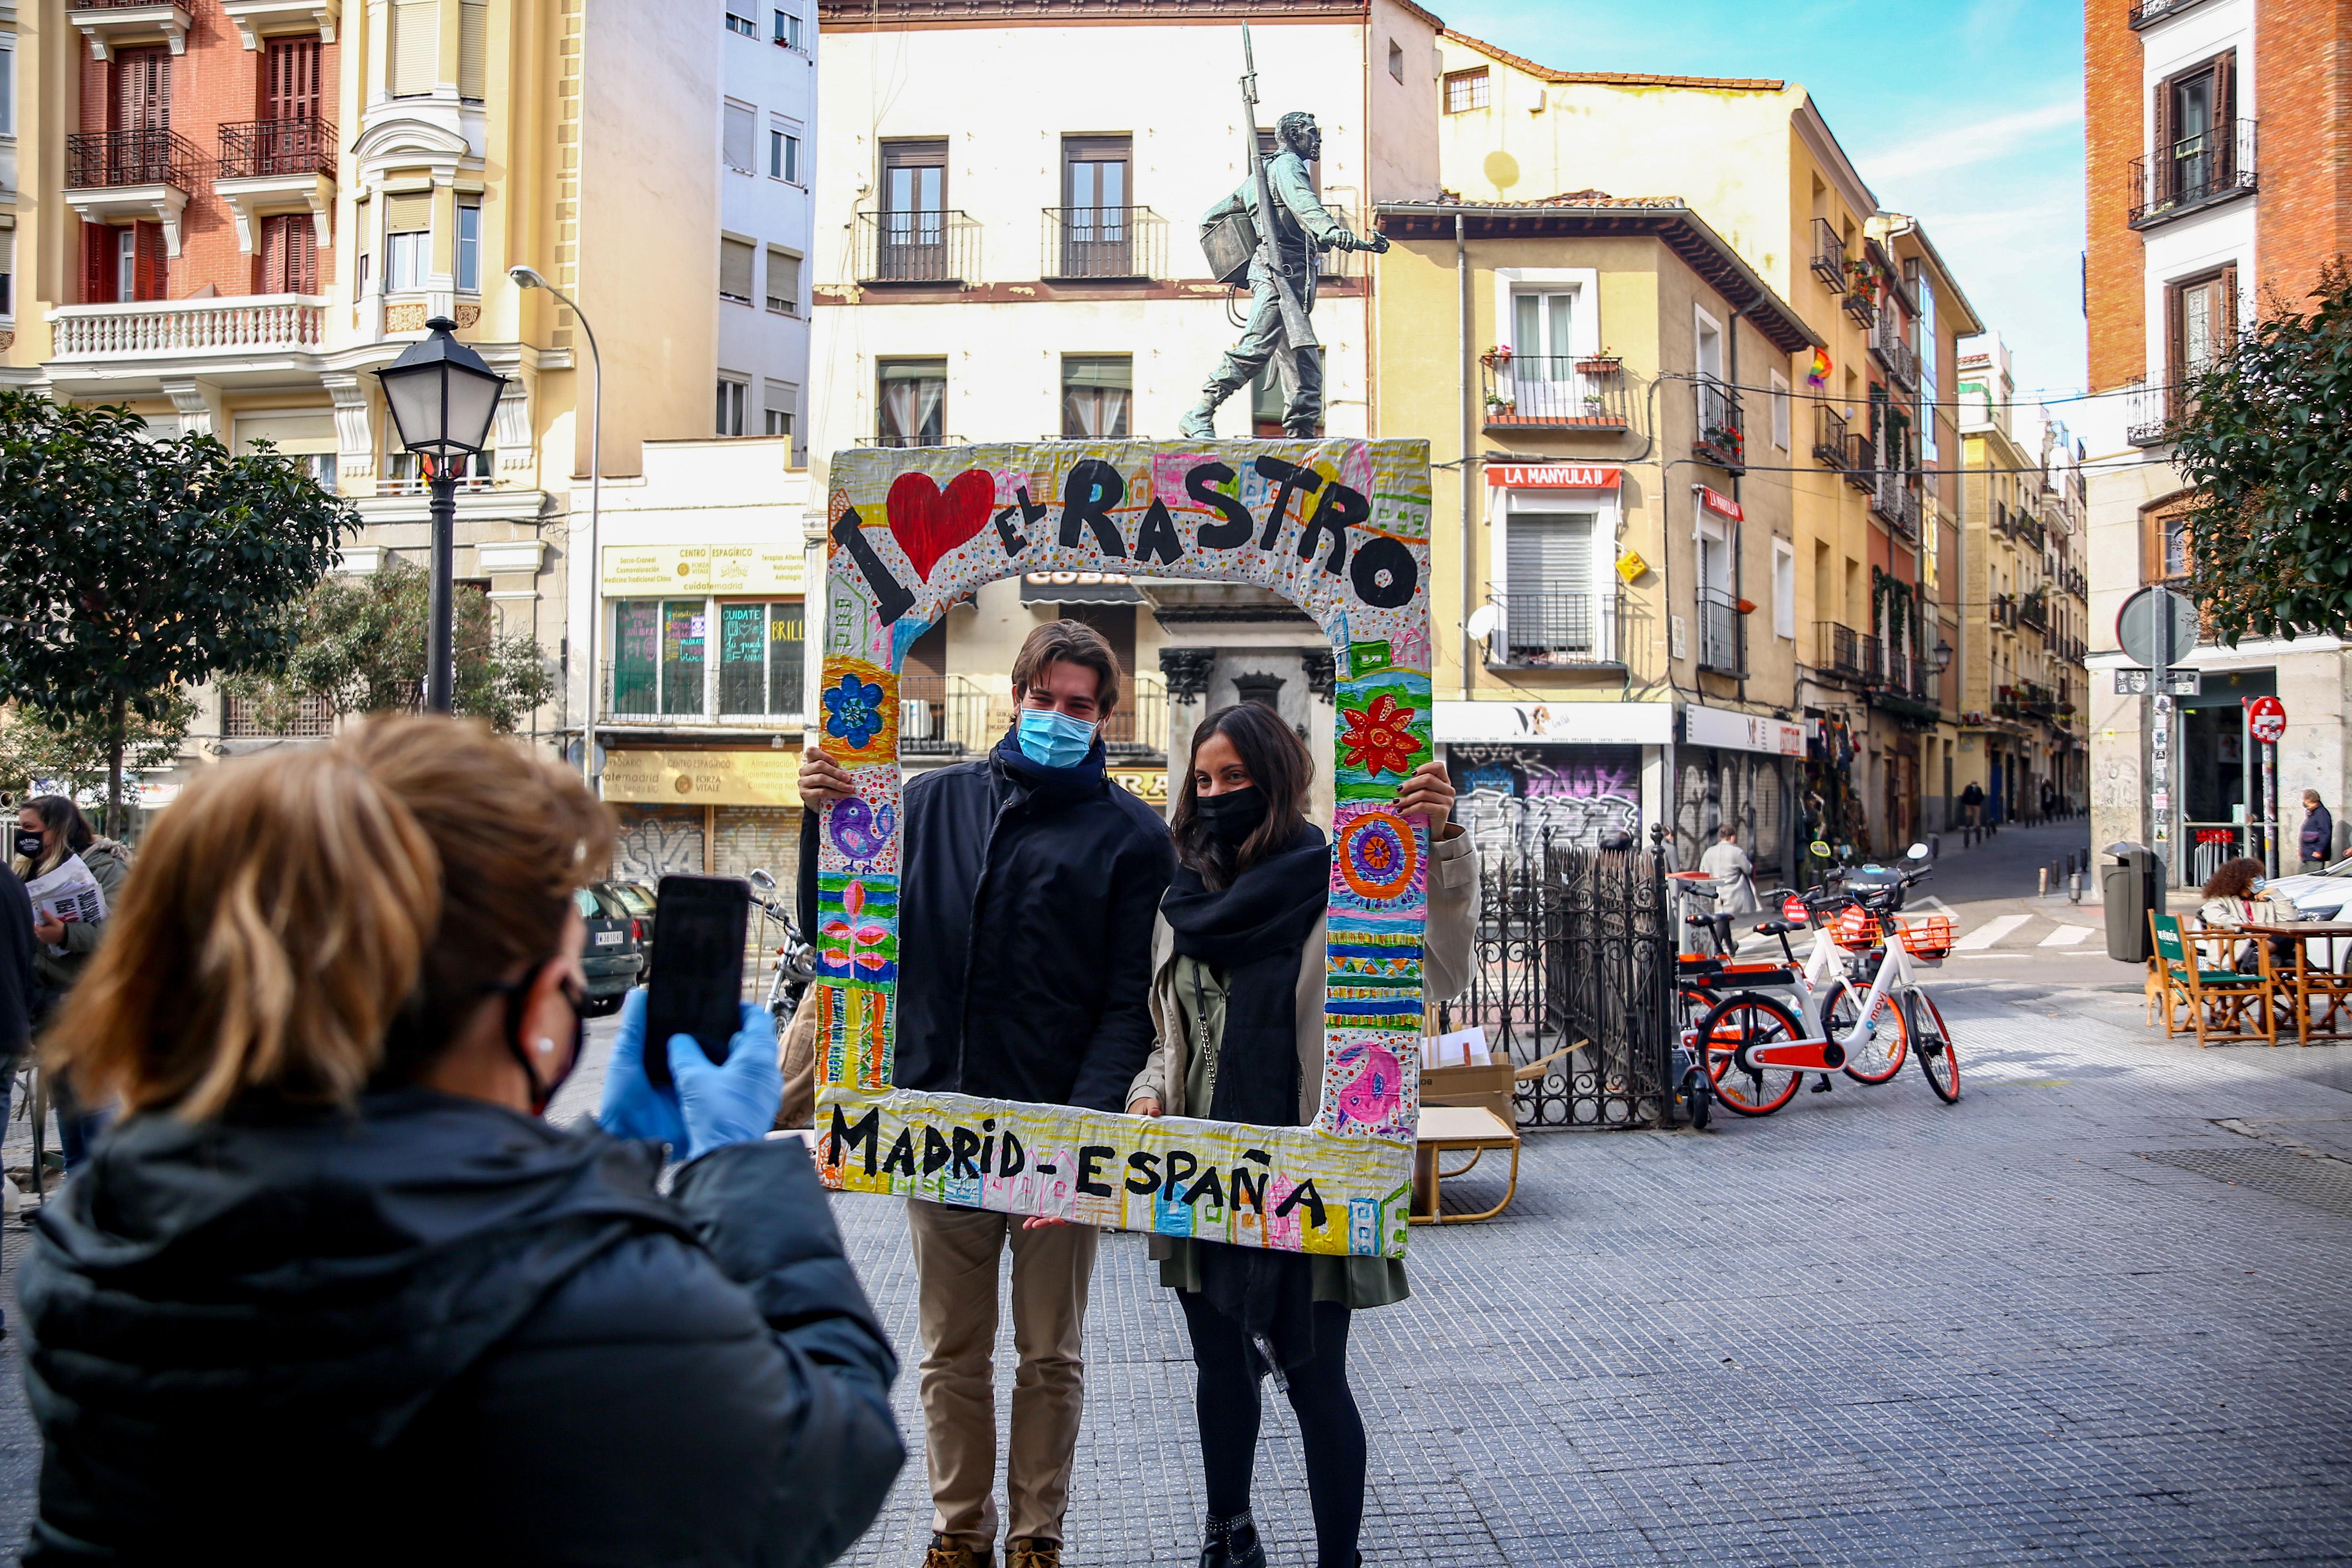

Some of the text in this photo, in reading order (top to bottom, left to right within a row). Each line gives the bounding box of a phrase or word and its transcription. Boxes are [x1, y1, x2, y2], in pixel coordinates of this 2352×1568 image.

[1505, 468, 1602, 485] LA MANYULA II
[831, 455, 1417, 628] I EL RASTRO
[680, 547, 753, 557] CENTRO ESPAGÍRICO
[684, 581, 743, 590] cuídatemadrid
[667, 759, 731, 768] CENTRO ESPAGÍRICO
[742, 771, 783, 780] Suplementos
[624, 784, 645, 793] tienda
[1870, 990, 1887, 1022] movi
[1076, 1146, 1326, 1228] ESPAÑA
